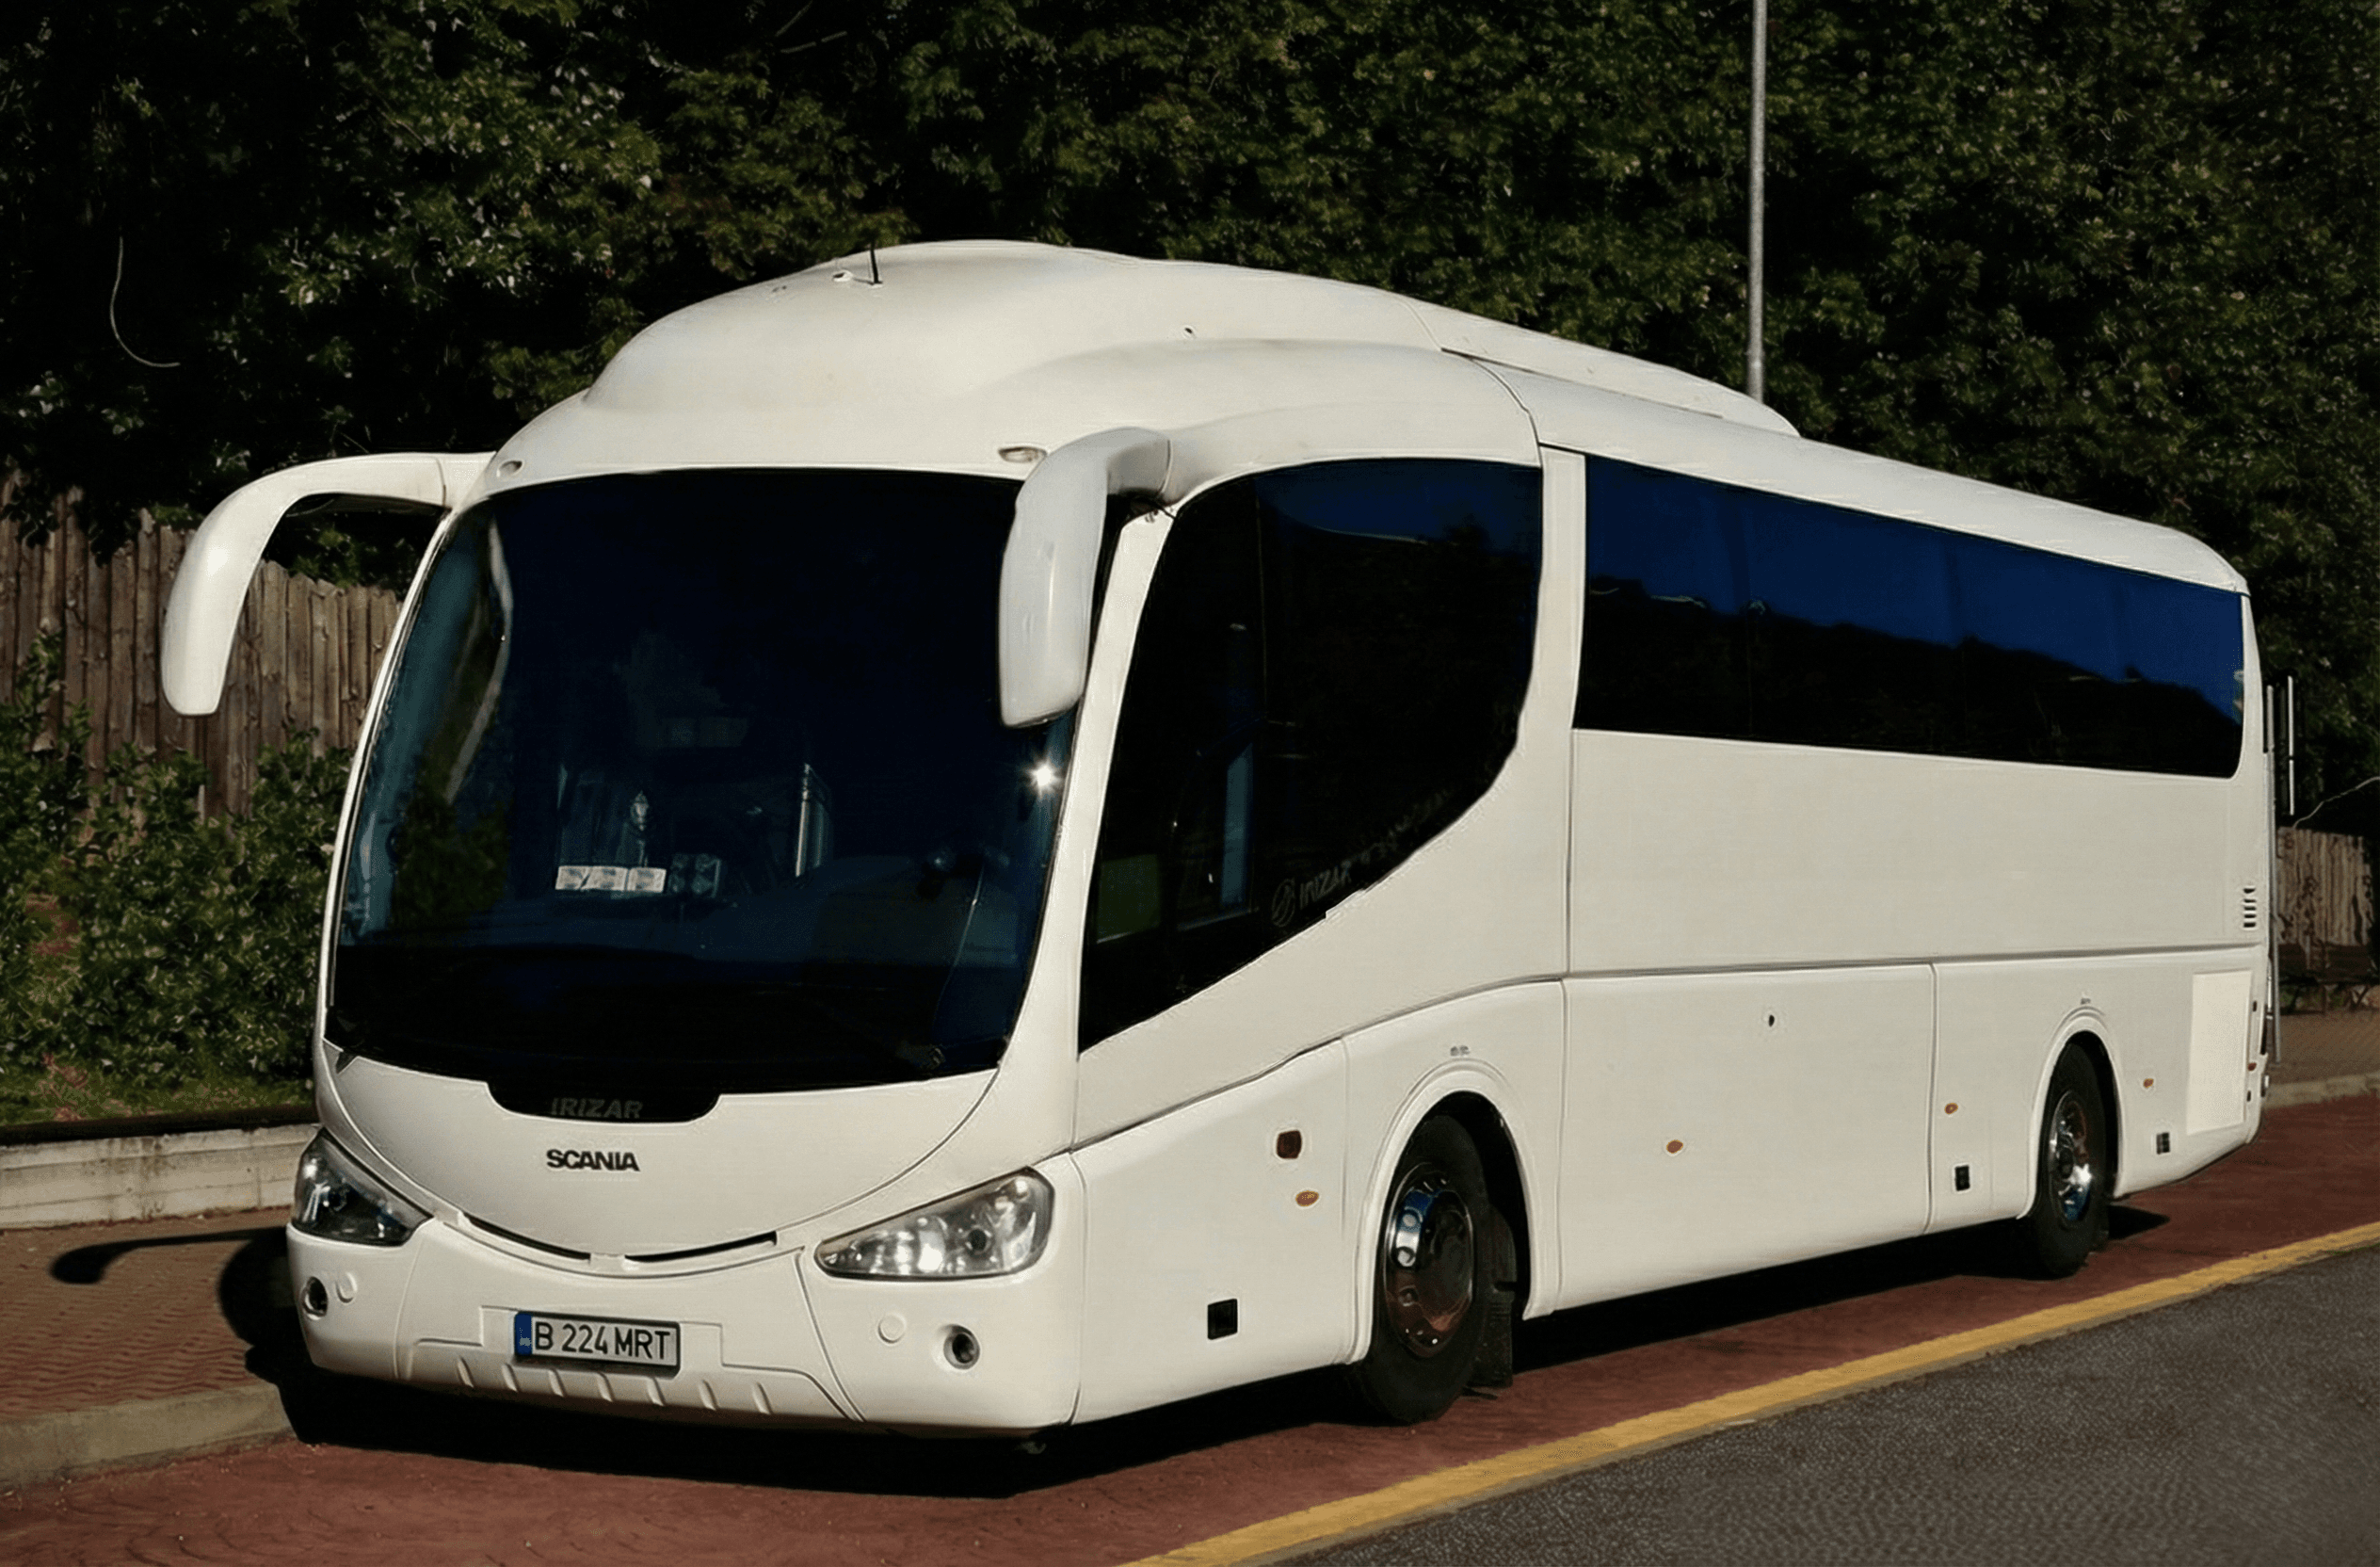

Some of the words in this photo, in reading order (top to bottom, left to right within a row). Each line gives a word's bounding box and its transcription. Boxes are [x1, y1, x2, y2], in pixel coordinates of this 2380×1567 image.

[550, 1096, 643, 1119] IRIZAR
[546, 1149, 640, 1171] SCANIA
[535, 1321, 554, 1350] B
[561, 1323, 608, 1354] 224
[615, 1326, 670, 1360] MRT
